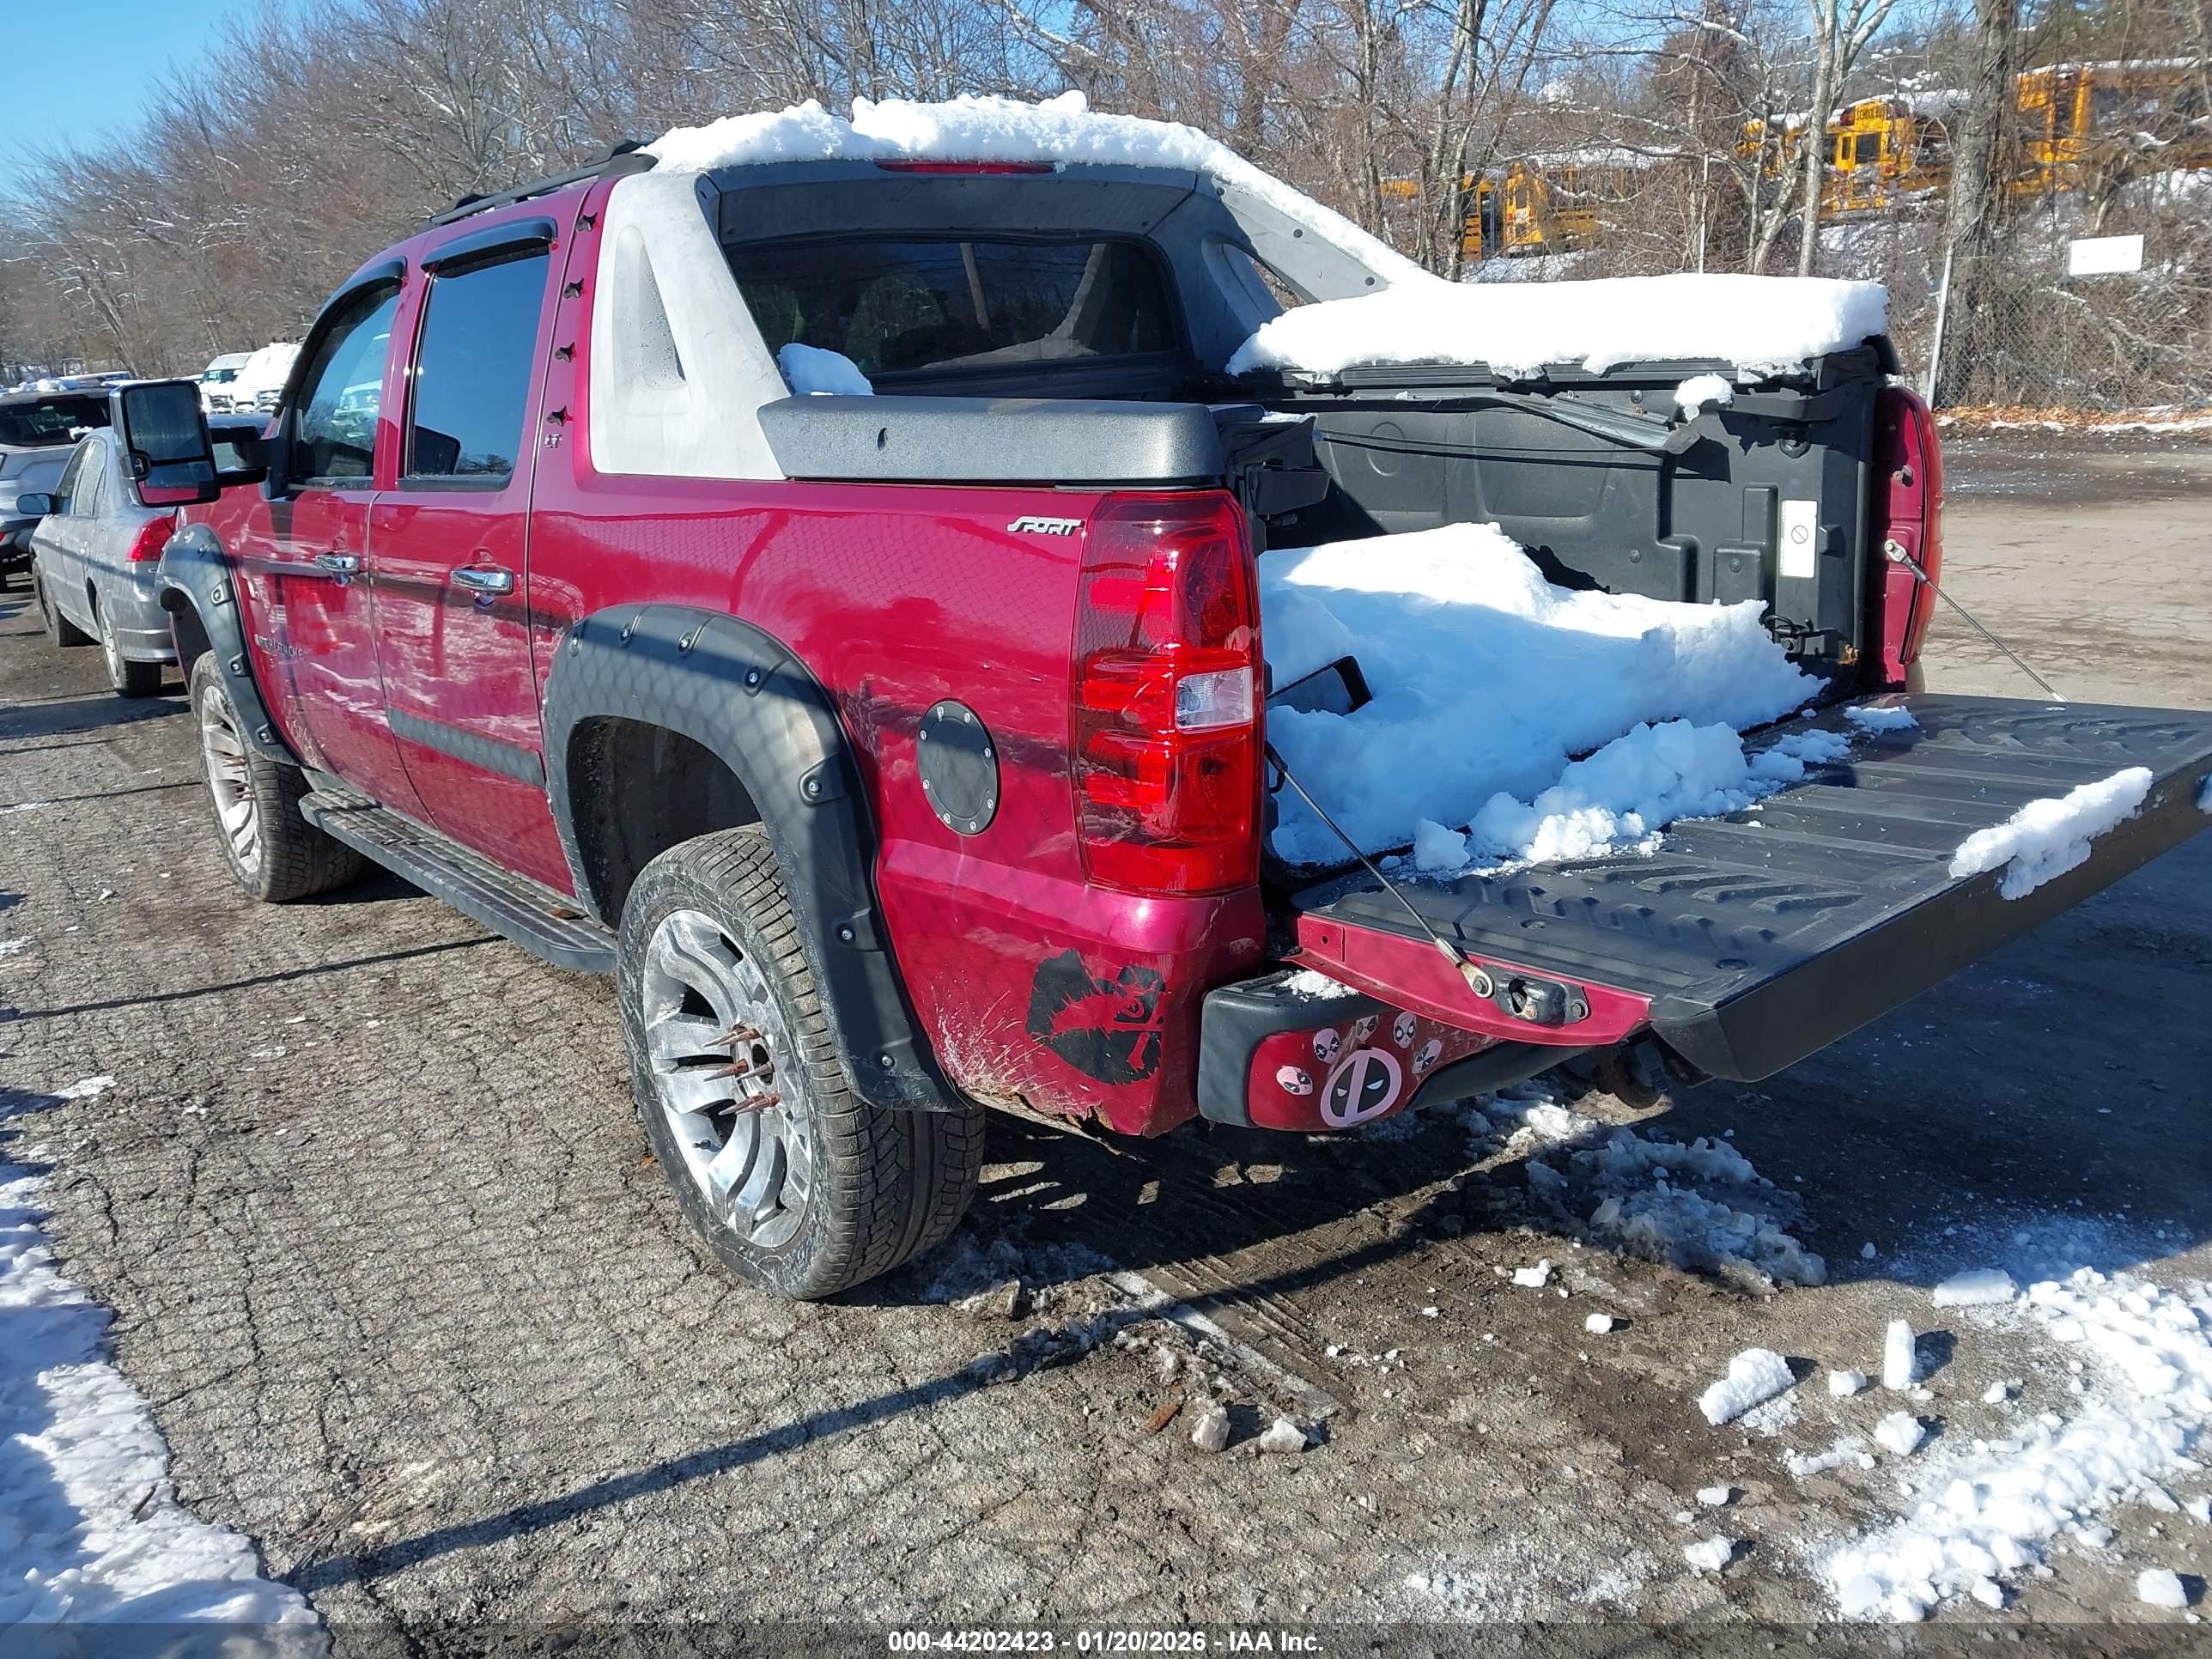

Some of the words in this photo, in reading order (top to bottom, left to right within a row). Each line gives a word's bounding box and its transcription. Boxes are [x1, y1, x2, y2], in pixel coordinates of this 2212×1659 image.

[1856, 107, 1875, 120] SCHOOL
[544, 433, 560, 448] LT
[1007, 515, 1082, 536] SPORT
